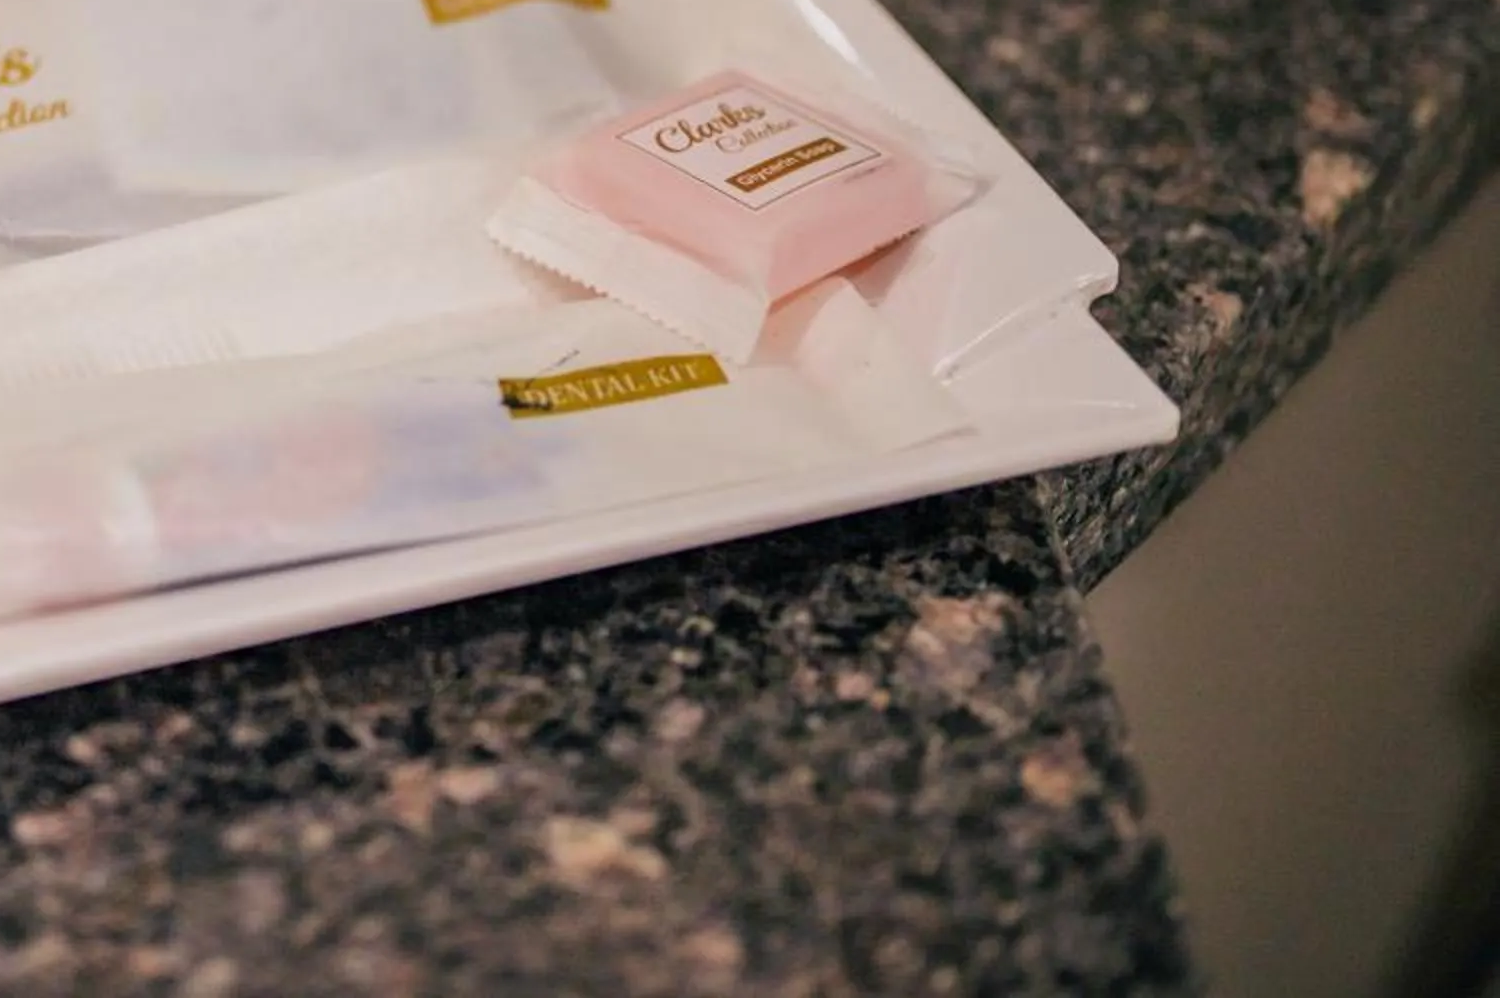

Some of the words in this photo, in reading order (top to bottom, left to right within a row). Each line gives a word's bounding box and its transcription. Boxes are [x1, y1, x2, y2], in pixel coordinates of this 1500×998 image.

[654, 102, 766, 153] Clarks
[524, 371, 643, 409] DENTAL
[649, 360, 700, 389] KIT
